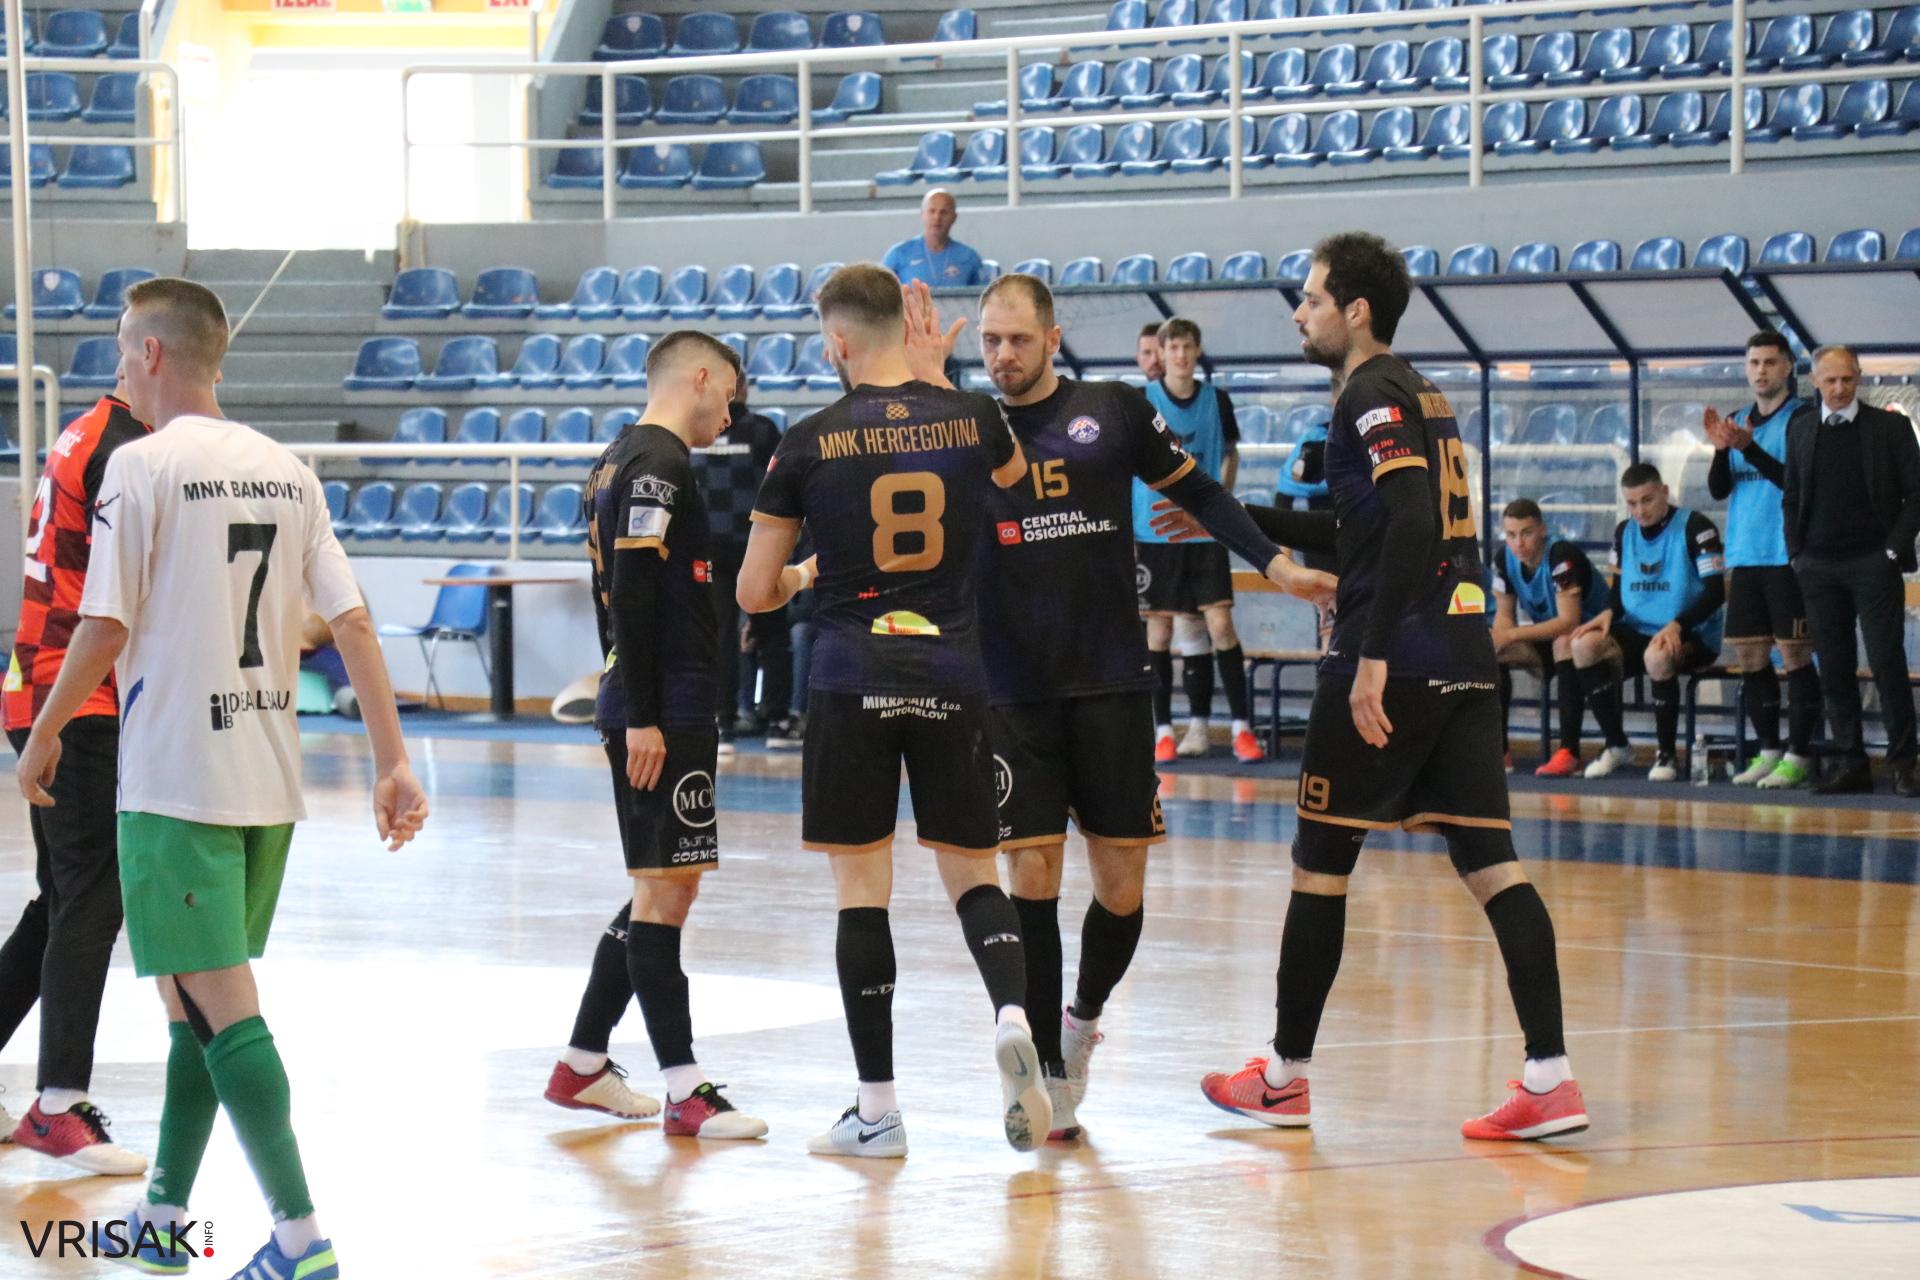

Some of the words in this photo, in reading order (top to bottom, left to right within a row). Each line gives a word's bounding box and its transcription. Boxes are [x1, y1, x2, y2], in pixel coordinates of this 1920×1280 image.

[819, 430, 861, 460] MNK
[864, 417, 980, 454] HERCEGOVINA
[183, 481, 228, 501] MNK
[1031, 458, 1069, 500] 15
[1438, 437, 1477, 540] 19
[870, 471, 946, 573] 8
[1022, 511, 1088, 529] CENTRAL
[1024, 520, 1111, 542] OSIGURANJE
[228, 523, 277, 668] 7
[679, 788, 715, 811] MC
[1300, 770, 1330, 811] 19
